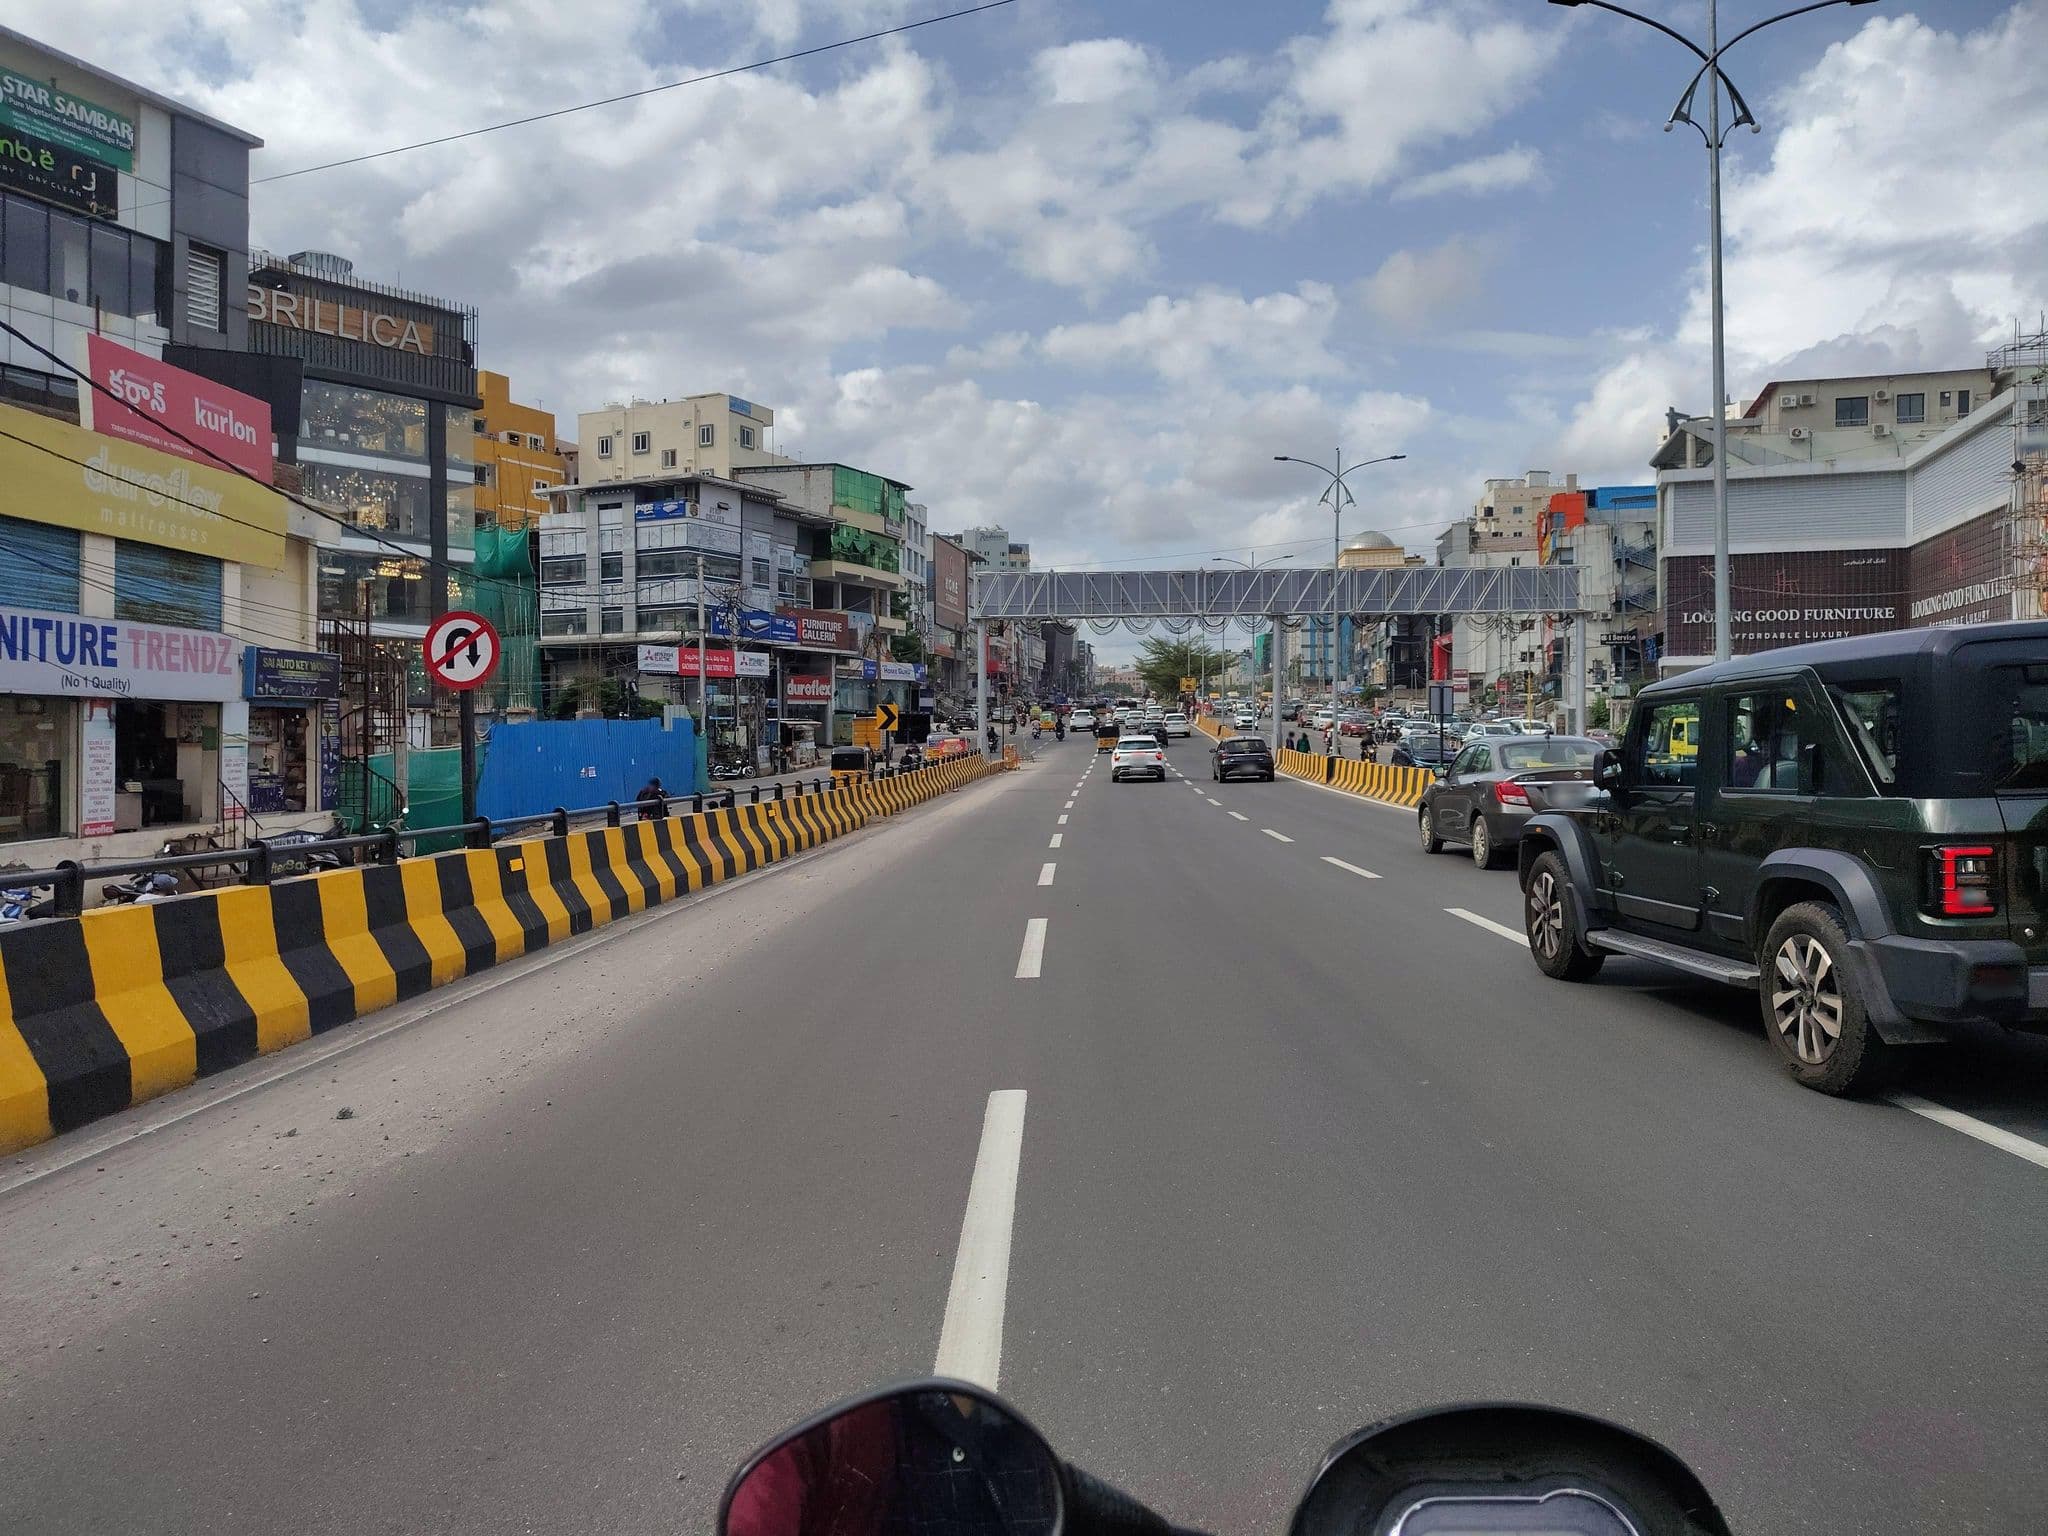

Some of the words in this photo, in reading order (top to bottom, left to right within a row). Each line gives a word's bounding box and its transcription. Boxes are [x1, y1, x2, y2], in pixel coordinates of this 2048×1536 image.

[3, 75, 51, 107] STAR
[54, 95, 133, 141] SAMBAR
[8, 96, 25, 110] Pure
[26, 102, 61, 123] Vegetarian
[62, 118, 93, 136] Authentic
[94, 129, 115, 147] Telugu
[116, 138, 131, 150] Food
[248, 284, 426, 355] BRILLICA
[194, 397, 257, 446] kurlon
[83, 446, 224, 524] duroflex
[101, 507, 208, 545] mattresses
[1755, 609, 1800, 622] GOOD
[1803, 607, 1896, 621] FURNITURE
[1911, 594, 1942, 619] LOOKING
[1942, 588, 1964, 611] GOOD
[801, 618, 843, 633] FURNITURE
[801, 629, 837, 643] GALLERIA
[1805, 630, 1851, 640] LUXURY
[127, 628, 233, 676] TRENDZ
[275, 658, 295, 670] AUTO
[296, 659, 309, 671] KEY
[61, 675, 80, 689] (No
[83, 676, 89, 689] 1
[92, 676, 131, 692] Quality)
[787, 679, 832, 697] duroflex
